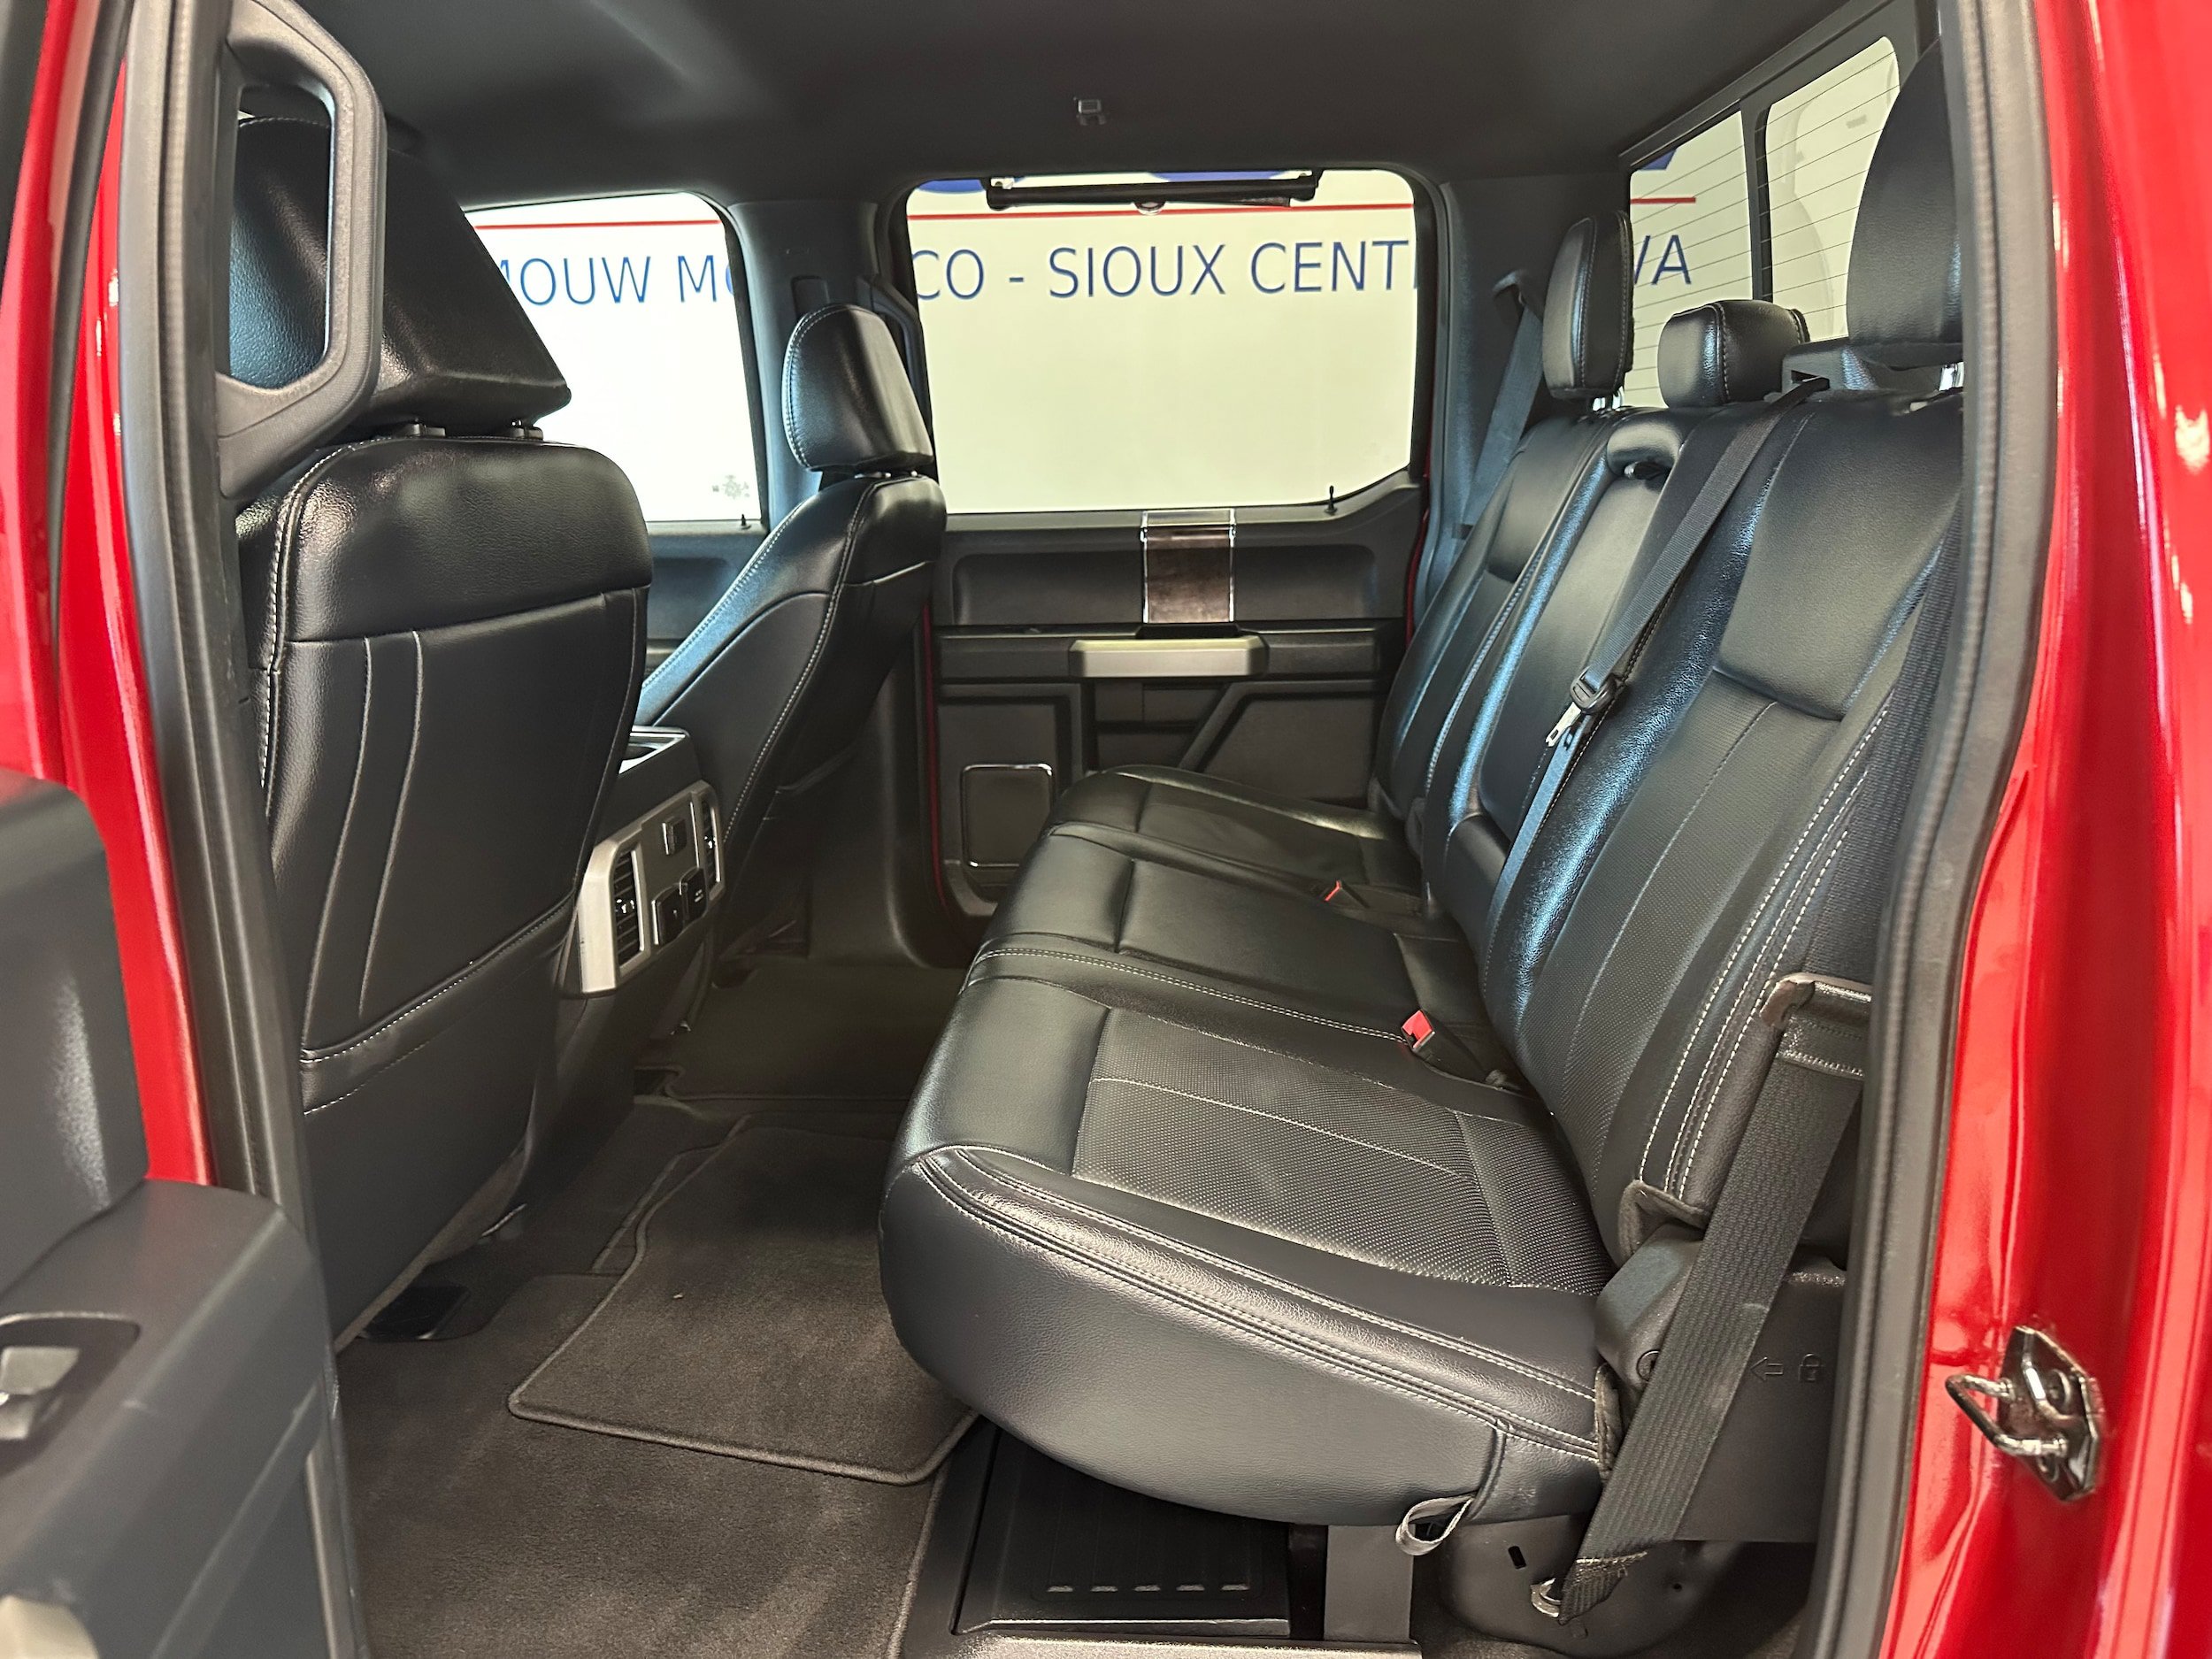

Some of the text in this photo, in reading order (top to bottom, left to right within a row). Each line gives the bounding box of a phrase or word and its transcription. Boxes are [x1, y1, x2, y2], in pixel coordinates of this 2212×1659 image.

[500, 256, 651, 306] OUW
[678, 255, 733, 303] M
[1049, 243, 1226, 298] SIOUX
[1251, 240, 1417, 294] CENT
